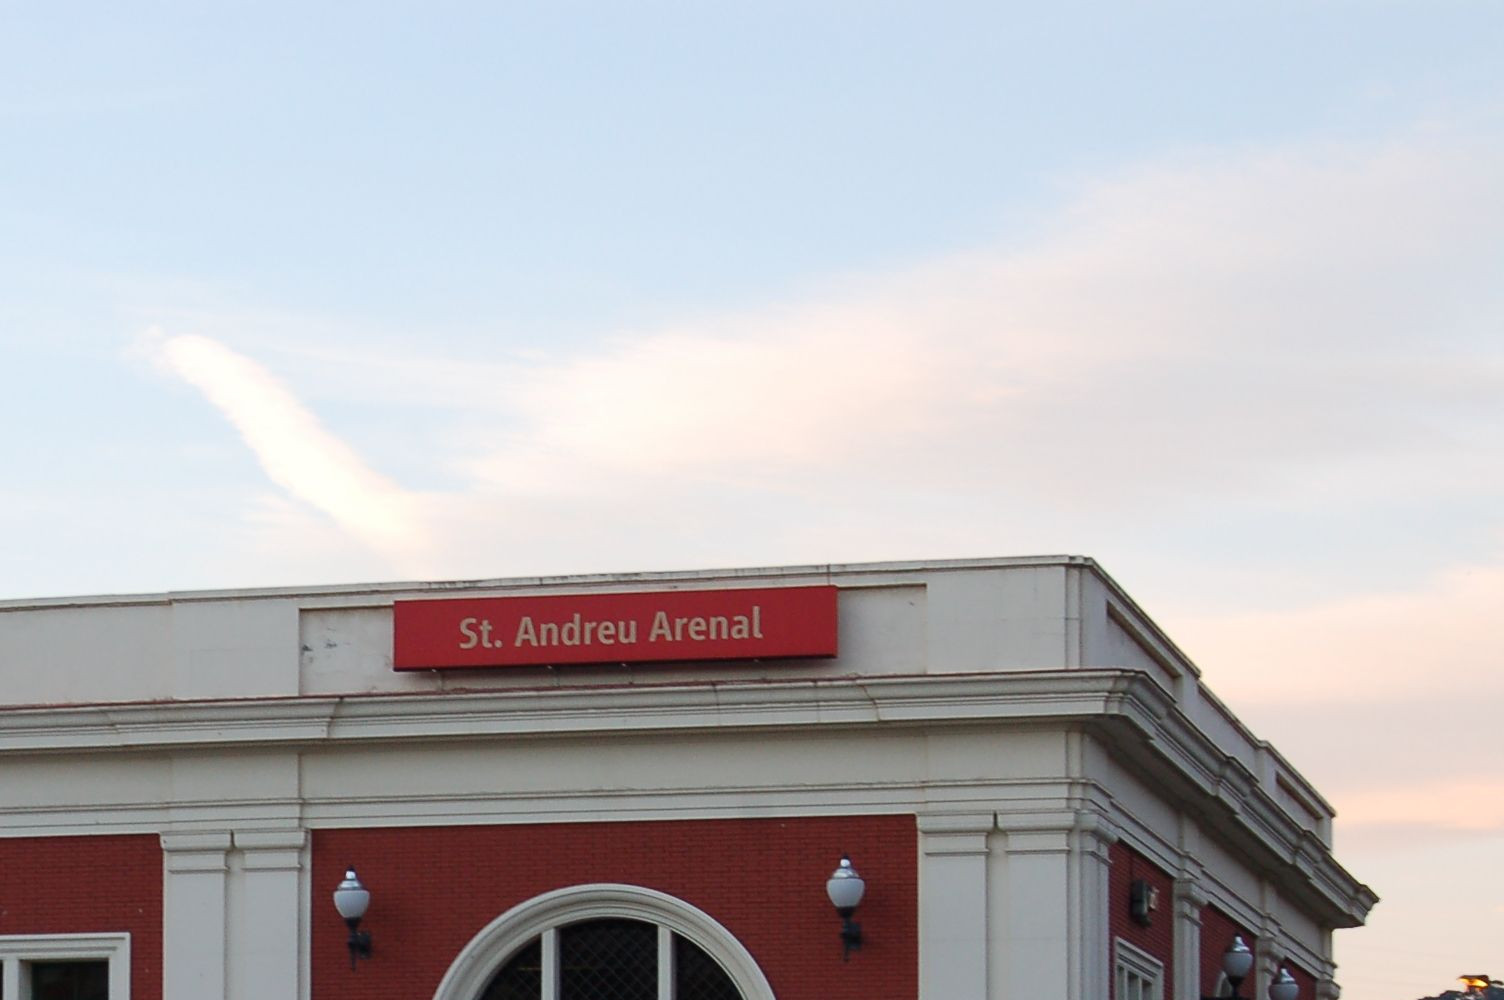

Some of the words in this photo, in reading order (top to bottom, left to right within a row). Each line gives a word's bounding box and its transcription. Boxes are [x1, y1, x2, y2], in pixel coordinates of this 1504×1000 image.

[459, 617, 503, 649] St.
[514, 613, 637, 647] Andreu
[648, 605, 763, 643] Arenal
